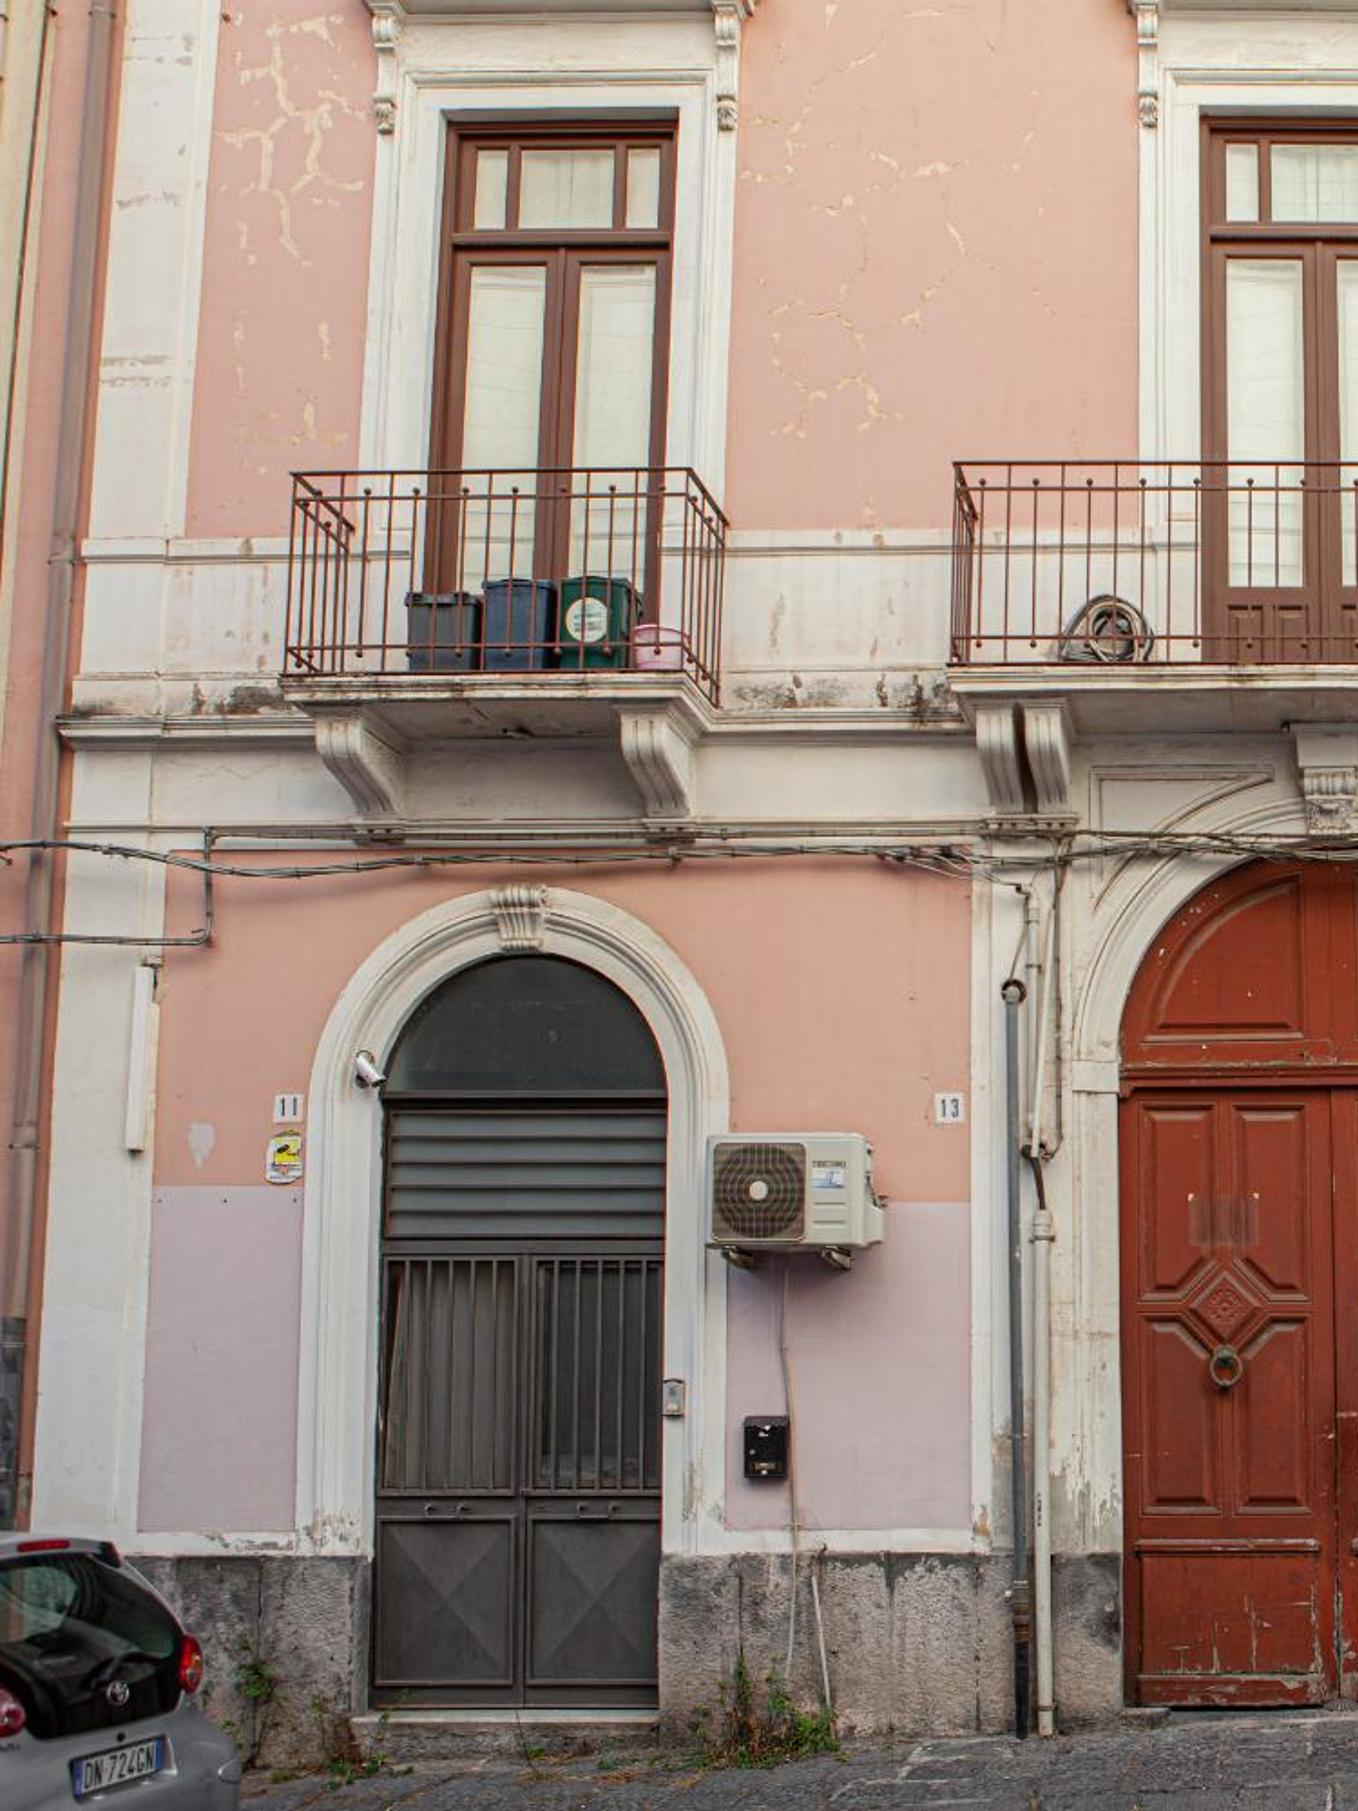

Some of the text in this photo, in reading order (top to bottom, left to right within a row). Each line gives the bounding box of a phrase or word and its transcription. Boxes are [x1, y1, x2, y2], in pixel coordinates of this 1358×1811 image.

[281, 1096, 297, 1116] 11
[941, 1098, 959, 1118] 13
[84, 1760, 104, 1789] DN
